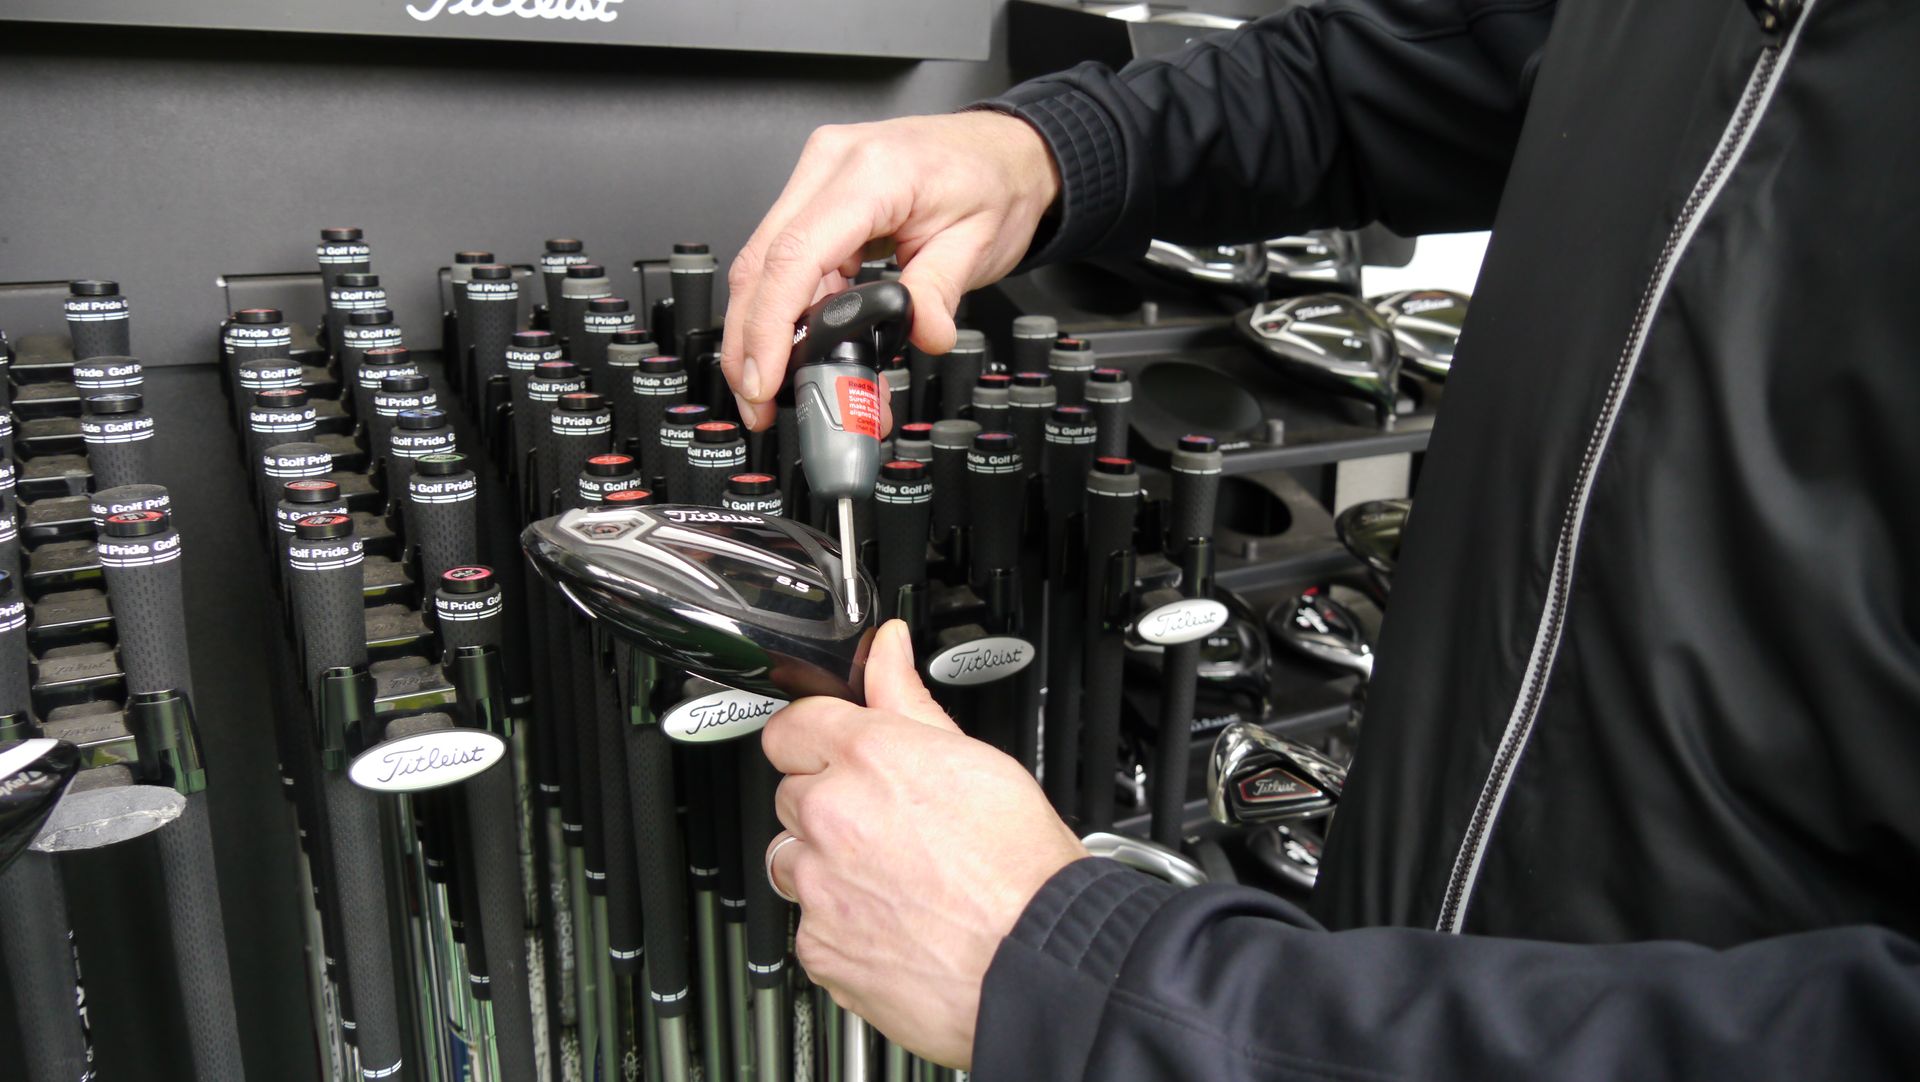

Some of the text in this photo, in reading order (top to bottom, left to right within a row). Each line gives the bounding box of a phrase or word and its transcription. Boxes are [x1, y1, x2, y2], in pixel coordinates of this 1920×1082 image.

[326, 246, 347, 255] Golf
[484, 284, 510, 292] Pride
[341, 291, 363, 299] Golf
[69, 302, 89, 311] Golf
[91, 301, 122, 310] Pride
[595, 317, 622, 325] Pride
[238, 328, 269, 338] Pride
[360, 330, 382, 339] Golf
[513, 352, 541, 361] Pride
[76, 367, 104, 377] Pride
[108, 363, 134, 375] Golf
[262, 366, 287, 378] Golf
[365, 368, 387, 379] Golf
[663, 375, 683, 386] Golf
[531, 383, 550, 392] Golf
[552, 382, 579, 392] Pride
[388, 397, 420, 407] Pride
[269, 411, 302, 423] Pride
[563, 416, 593, 426] Pride
[595, 412, 611, 424] Gol
[104, 420, 133, 433] Golf
[1062, 425, 1082, 436] Golf
[668, 429, 694, 439] Pride
[392, 436, 412, 446] Golf
[414, 436, 446, 446] Pride
[703, 448, 733, 458] Pride
[278, 456, 305, 467] Golf
[988, 455, 1011, 465] Golf
[418, 481, 443, 493] Golf
[446, 480, 473, 492] Pride
[603, 480, 628, 492] Golf
[900, 484, 923, 495] Golf
[112, 499, 143, 514] Golf
[731, 501, 755, 511] Golf
[663, 509, 765, 524] Titleist
[110, 542, 149, 555] Pride
[289, 546, 309, 558] Golf
[311, 545, 349, 558] Pride
[450, 600, 484, 611] Pride
[1154, 608, 1216, 637] Titleist
[948, 647, 1022, 678] Titleist
[685, 700, 774, 735] Titleist
[377, 745, 486, 782] Titleist
[1252, 778, 1296, 796] Titleist
[560, 911, 575, 971] ROGUE
